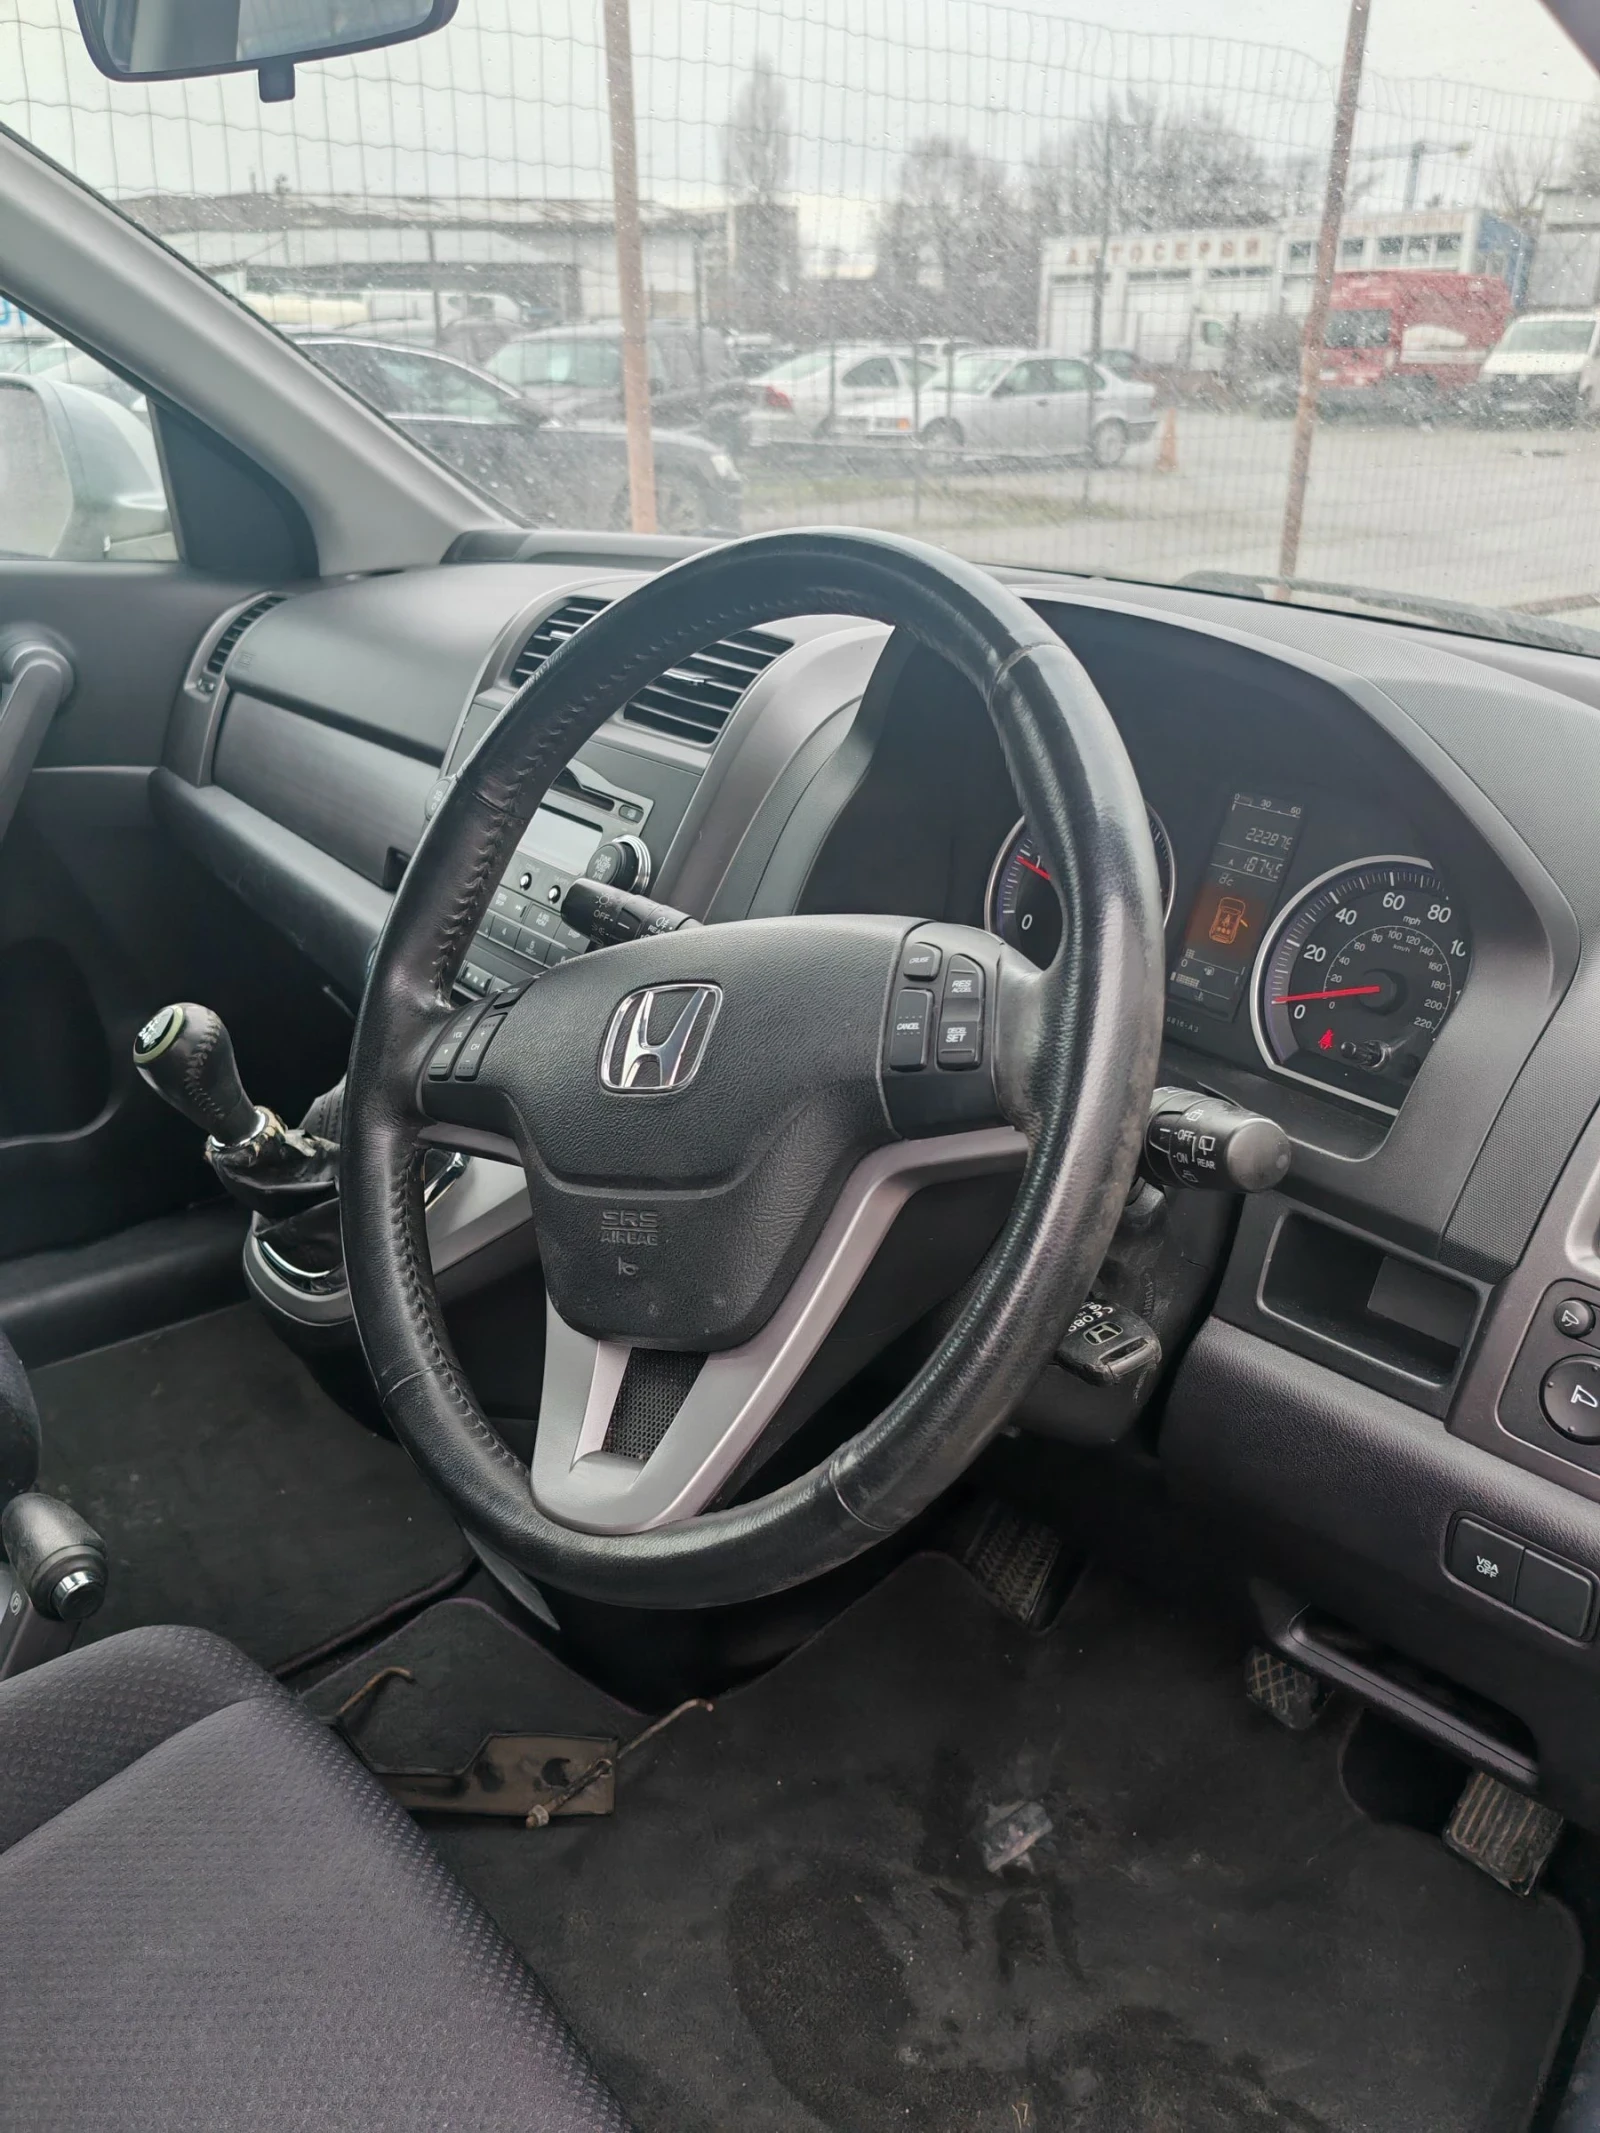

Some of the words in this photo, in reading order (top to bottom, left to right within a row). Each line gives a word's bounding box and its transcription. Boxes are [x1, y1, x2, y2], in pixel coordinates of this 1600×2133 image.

[1261, 799, 1272, 808] 30
[1382, 892, 1405, 911] 60
[593, 909, 610, 921] OFF
[1335, 908, 1357, 925] 40
[1427, 904, 1451, 923] 80
[1021, 914, 1032, 930] 0
[1402, 915, 1421, 926] mph
[1371, 933, 1383, 943] 80
[1388, 930, 1402, 940] 100
[1405, 935, 1420, 946] 120
[1354, 942, 1365, 951] 60
[1392, 943, 1410, 953] km/h
[1419, 946, 1434, 956] 140
[1303, 944, 1326, 962] 20
[1339, 956, 1350, 965] 40
[1428, 962, 1443, 972] 160
[952, 980, 972, 988] RES
[1330, 974, 1342, 983] 20
[1430, 980, 1446, 991] 180
[1329, 1001, 1335, 1009] 0
[1424, 999, 1442, 1010] 200
[1294, 1004, 1305, 1019] 0
[1414, 1017, 1432, 1029] 220
[946, 1033, 967, 1042] SET
[1177, 1129, 1195, 1142] OFF
[1176, 1152, 1189, 1164] ON
[1197, 1158, 1216, 1170] REAR
[601, 1209, 658, 1228] SRS
[601, 1230, 658, 1246] AIRBAG
[1476, 1555, 1499, 1574] VSA
[1476, 1564, 1498, 1578] OFF
